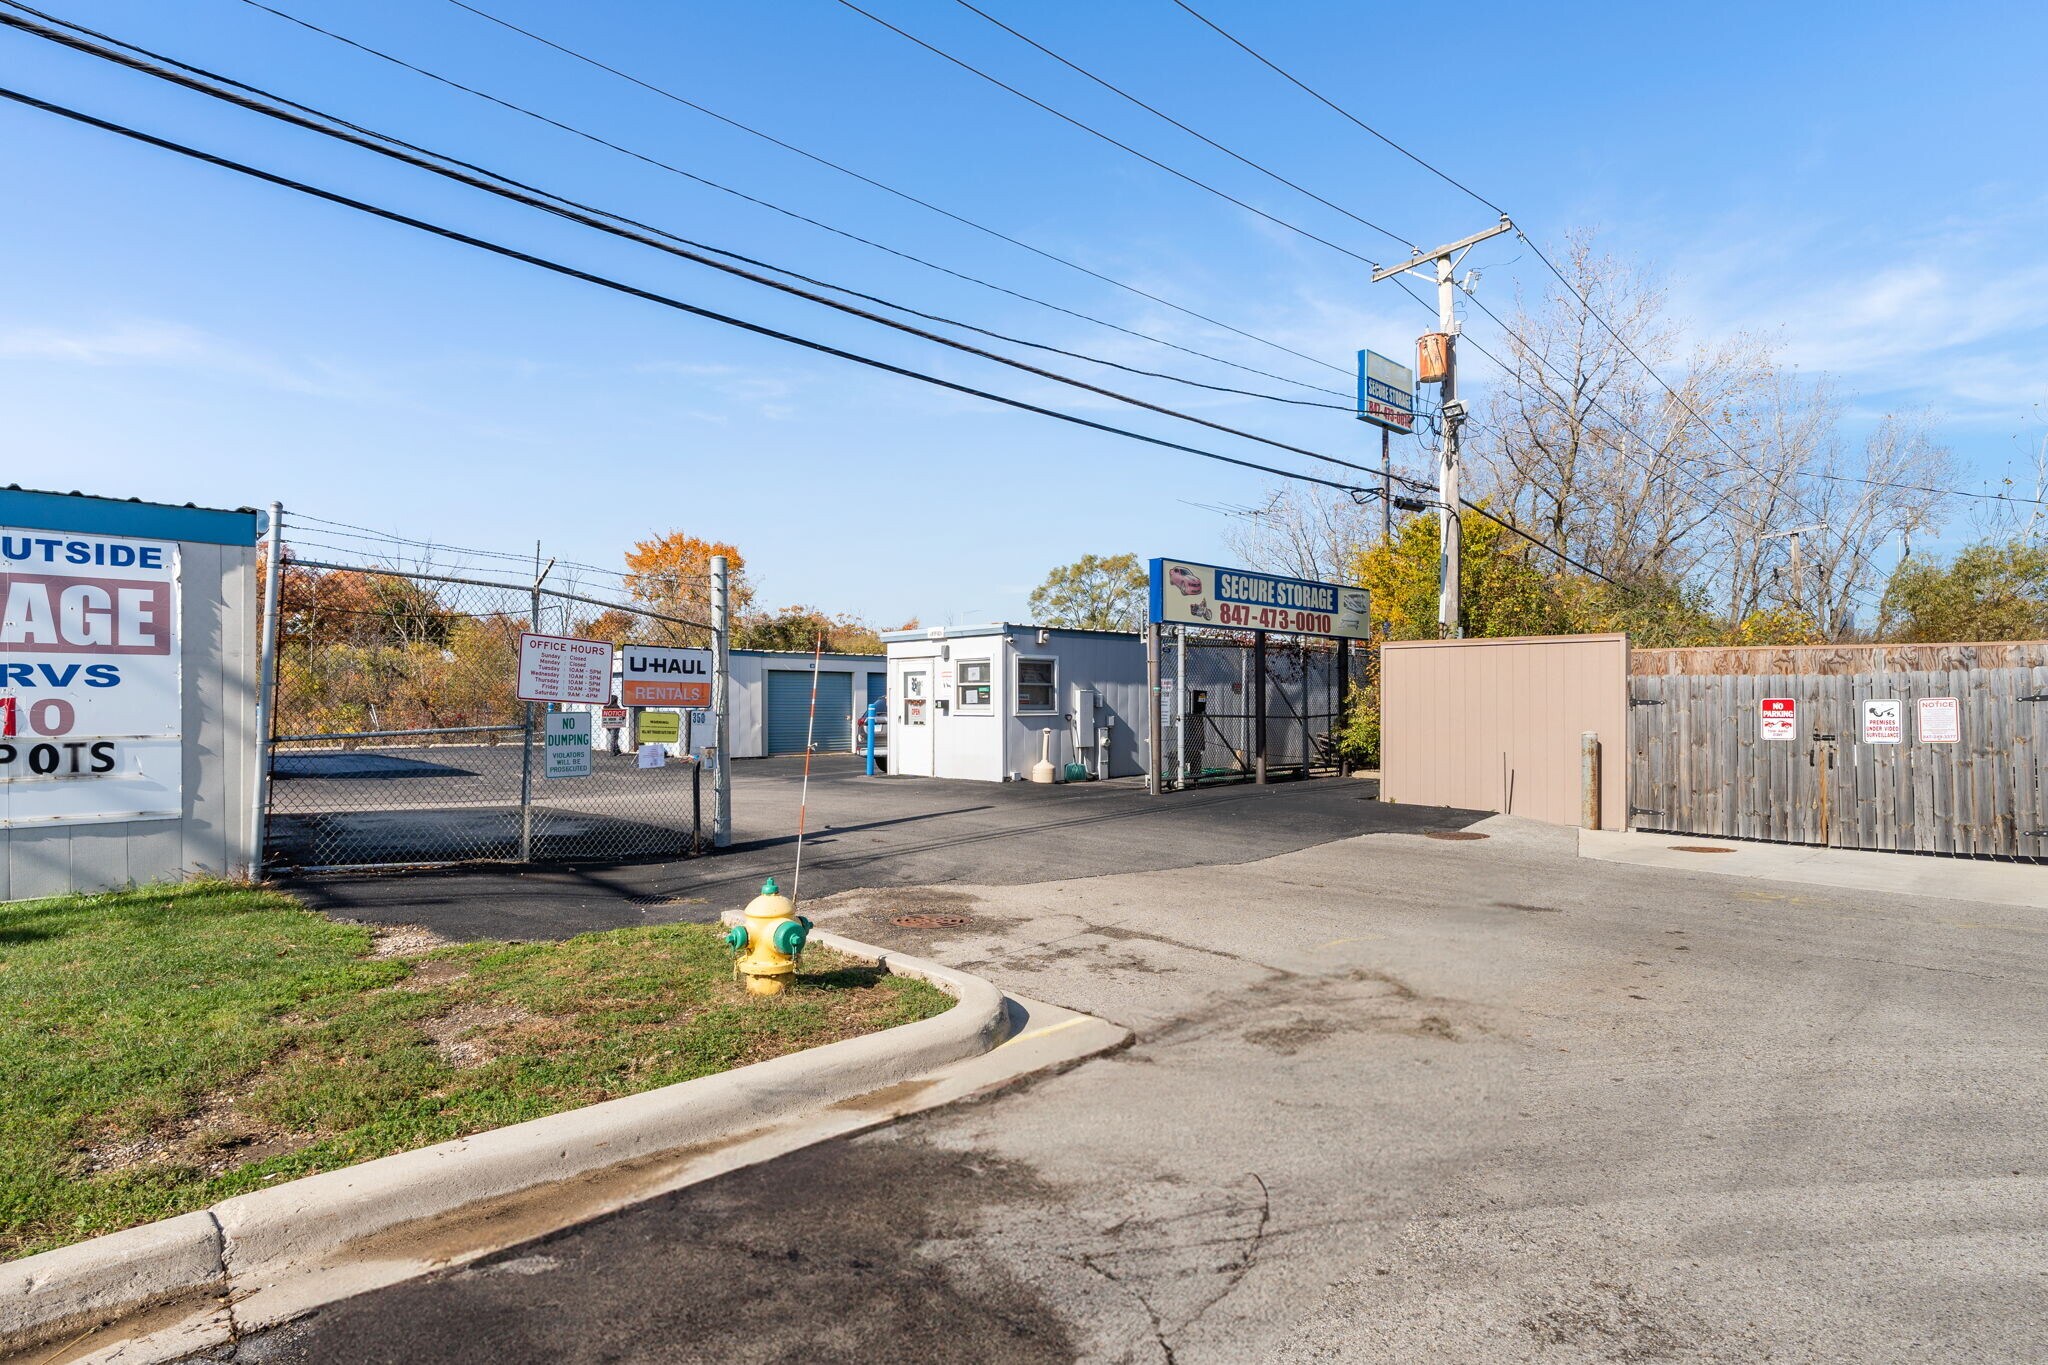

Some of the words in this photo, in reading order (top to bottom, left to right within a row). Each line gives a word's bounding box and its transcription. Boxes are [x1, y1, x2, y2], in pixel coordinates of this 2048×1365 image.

[1369, 379, 1387, 402] SECURE
[2, 536, 162, 569] UTSIDE
[1221, 573, 1275, 603] SECURE
[1277, 582, 1333, 611] STORAGE
[0, 581, 156, 647] AGE
[1220, 602, 1331, 634] 847-473-0010
[529, 640, 567, 652] OFFICE
[570, 644, 605, 656] HOURS
[630, 656, 706, 675] U-HAUL
[0, 663, 121, 688] RVS
[530, 670, 559, 678] Wednesday
[534, 689, 559, 697] Saturday
[635, 686, 700, 701] RENTALS
[1772, 702, 1784, 710] NO
[1763, 710, 1794, 718] PARKING
[562, 717, 575, 730] NO
[548, 733, 589, 747] DUMPING
[552, 751, 585, 759] VIOLATORS
[549, 765, 588, 773] PROSECUTED
